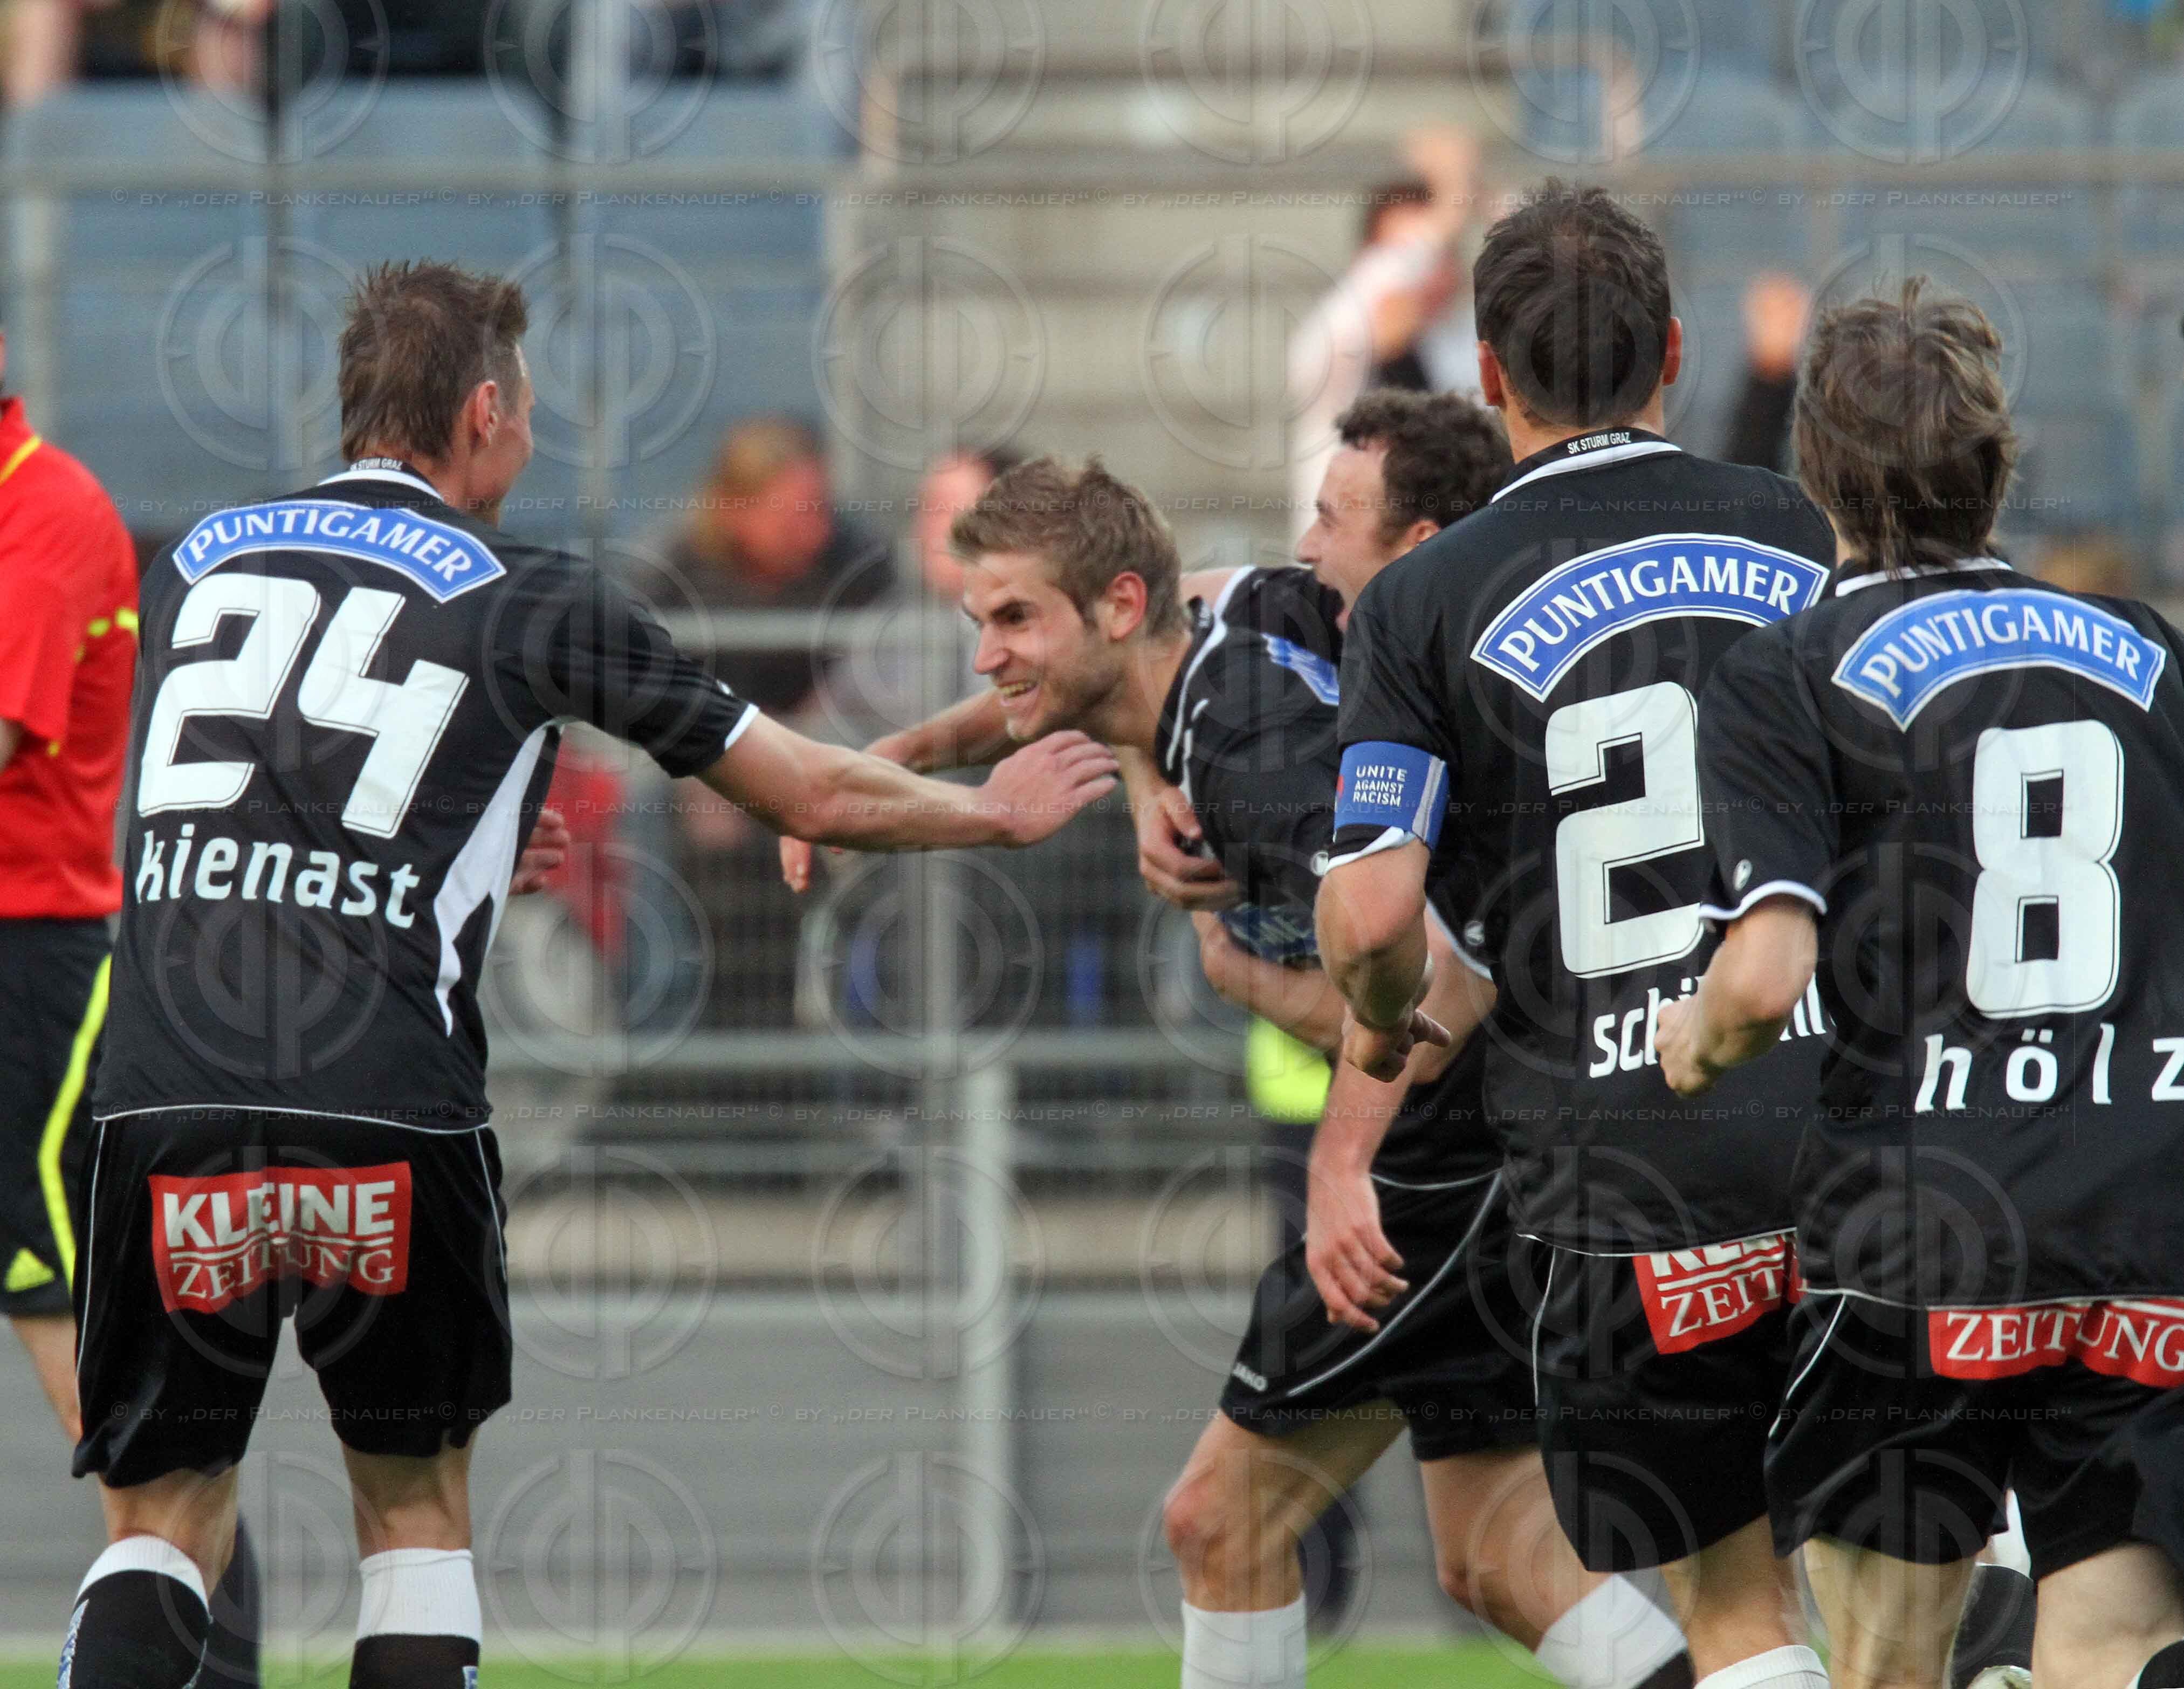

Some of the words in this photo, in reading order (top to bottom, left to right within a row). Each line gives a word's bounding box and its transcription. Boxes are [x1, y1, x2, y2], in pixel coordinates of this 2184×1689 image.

[358, 458, 381, 470] STURM
[381, 458, 403, 471] GRAZ
[1567, 440, 1581, 454] SK
[1580, 433, 1610, 451] STURM
[1610, 431, 1631, 445] GRAZ
[189, 509, 472, 582] PUNTIGAMER
[1498, 555, 1799, 672] PUNTIGAMER
[1861, 604, 2141, 698] PUNTIGAMER
[138, 573, 470, 839] 24
[1352, 791, 1401, 807] RACISM
[1354, 779, 1404, 794] AGAINST
[1356, 765, 1407, 782] UNITE
[1545, 681, 1705, 979] 2
[135, 823, 420, 929] kienast
[1966, 719, 2125, 1019] 8
[163, 1181, 395, 1247] KLEINE
[173, 1245, 395, 1299] ZEITUNG
[1661, 1265, 1784, 1337] ZEIT
